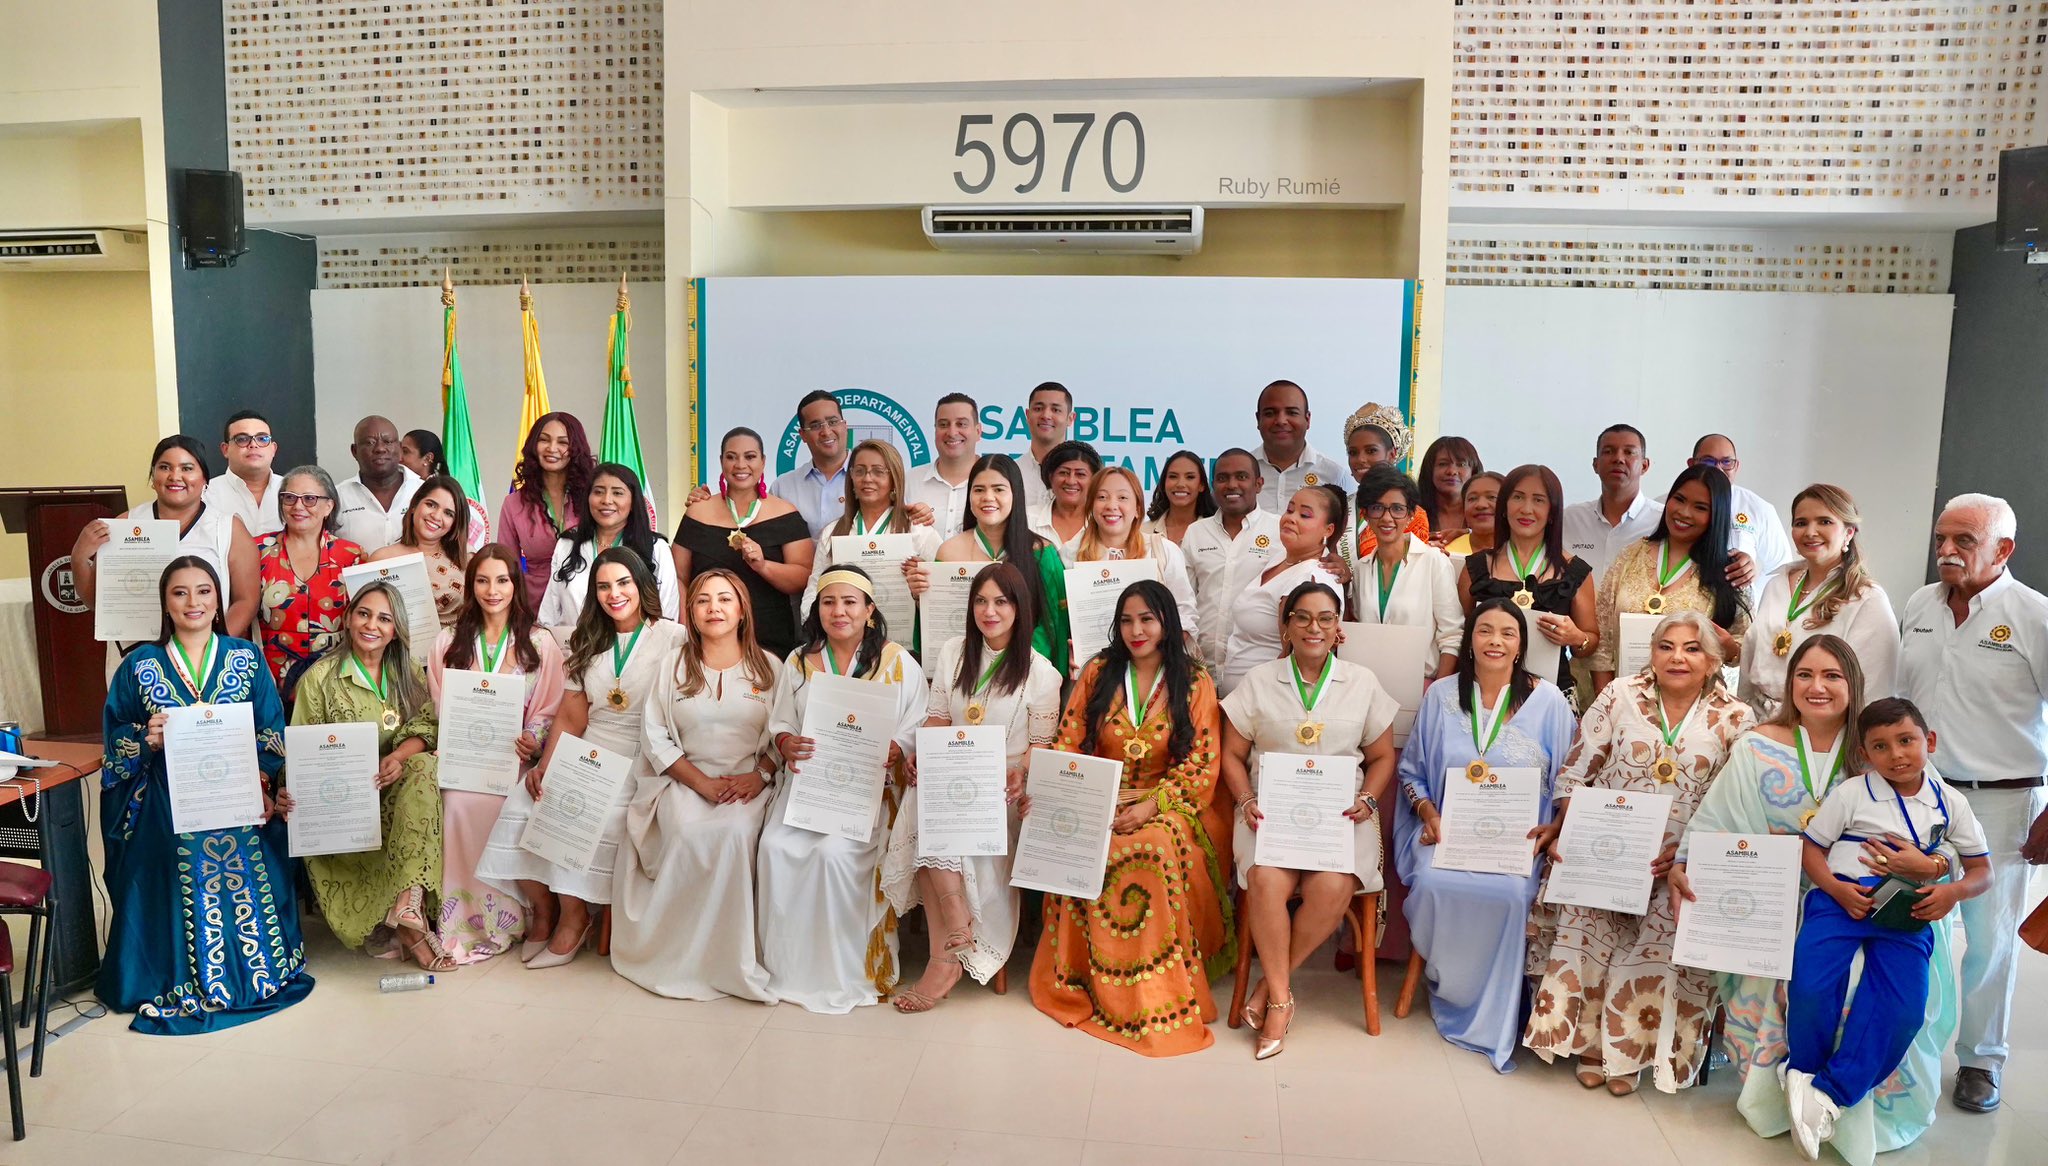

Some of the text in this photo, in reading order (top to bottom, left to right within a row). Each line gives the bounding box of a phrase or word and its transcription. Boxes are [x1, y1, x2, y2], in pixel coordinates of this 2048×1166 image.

[953, 111, 1146, 194] 5970
[1219, 177, 1341, 198] Ruby Rumié
[979, 404, 1185, 444] SABLEA
[1093, 577, 1120, 585] ASAMBLEA
[1979, 639, 2013, 649] ASAMBLEA
[837, 722, 863, 730] ASAMBLEA
[580, 755, 602, 767] ASAMBLEA
[1059, 769, 1084, 778] ASAMBLEA
